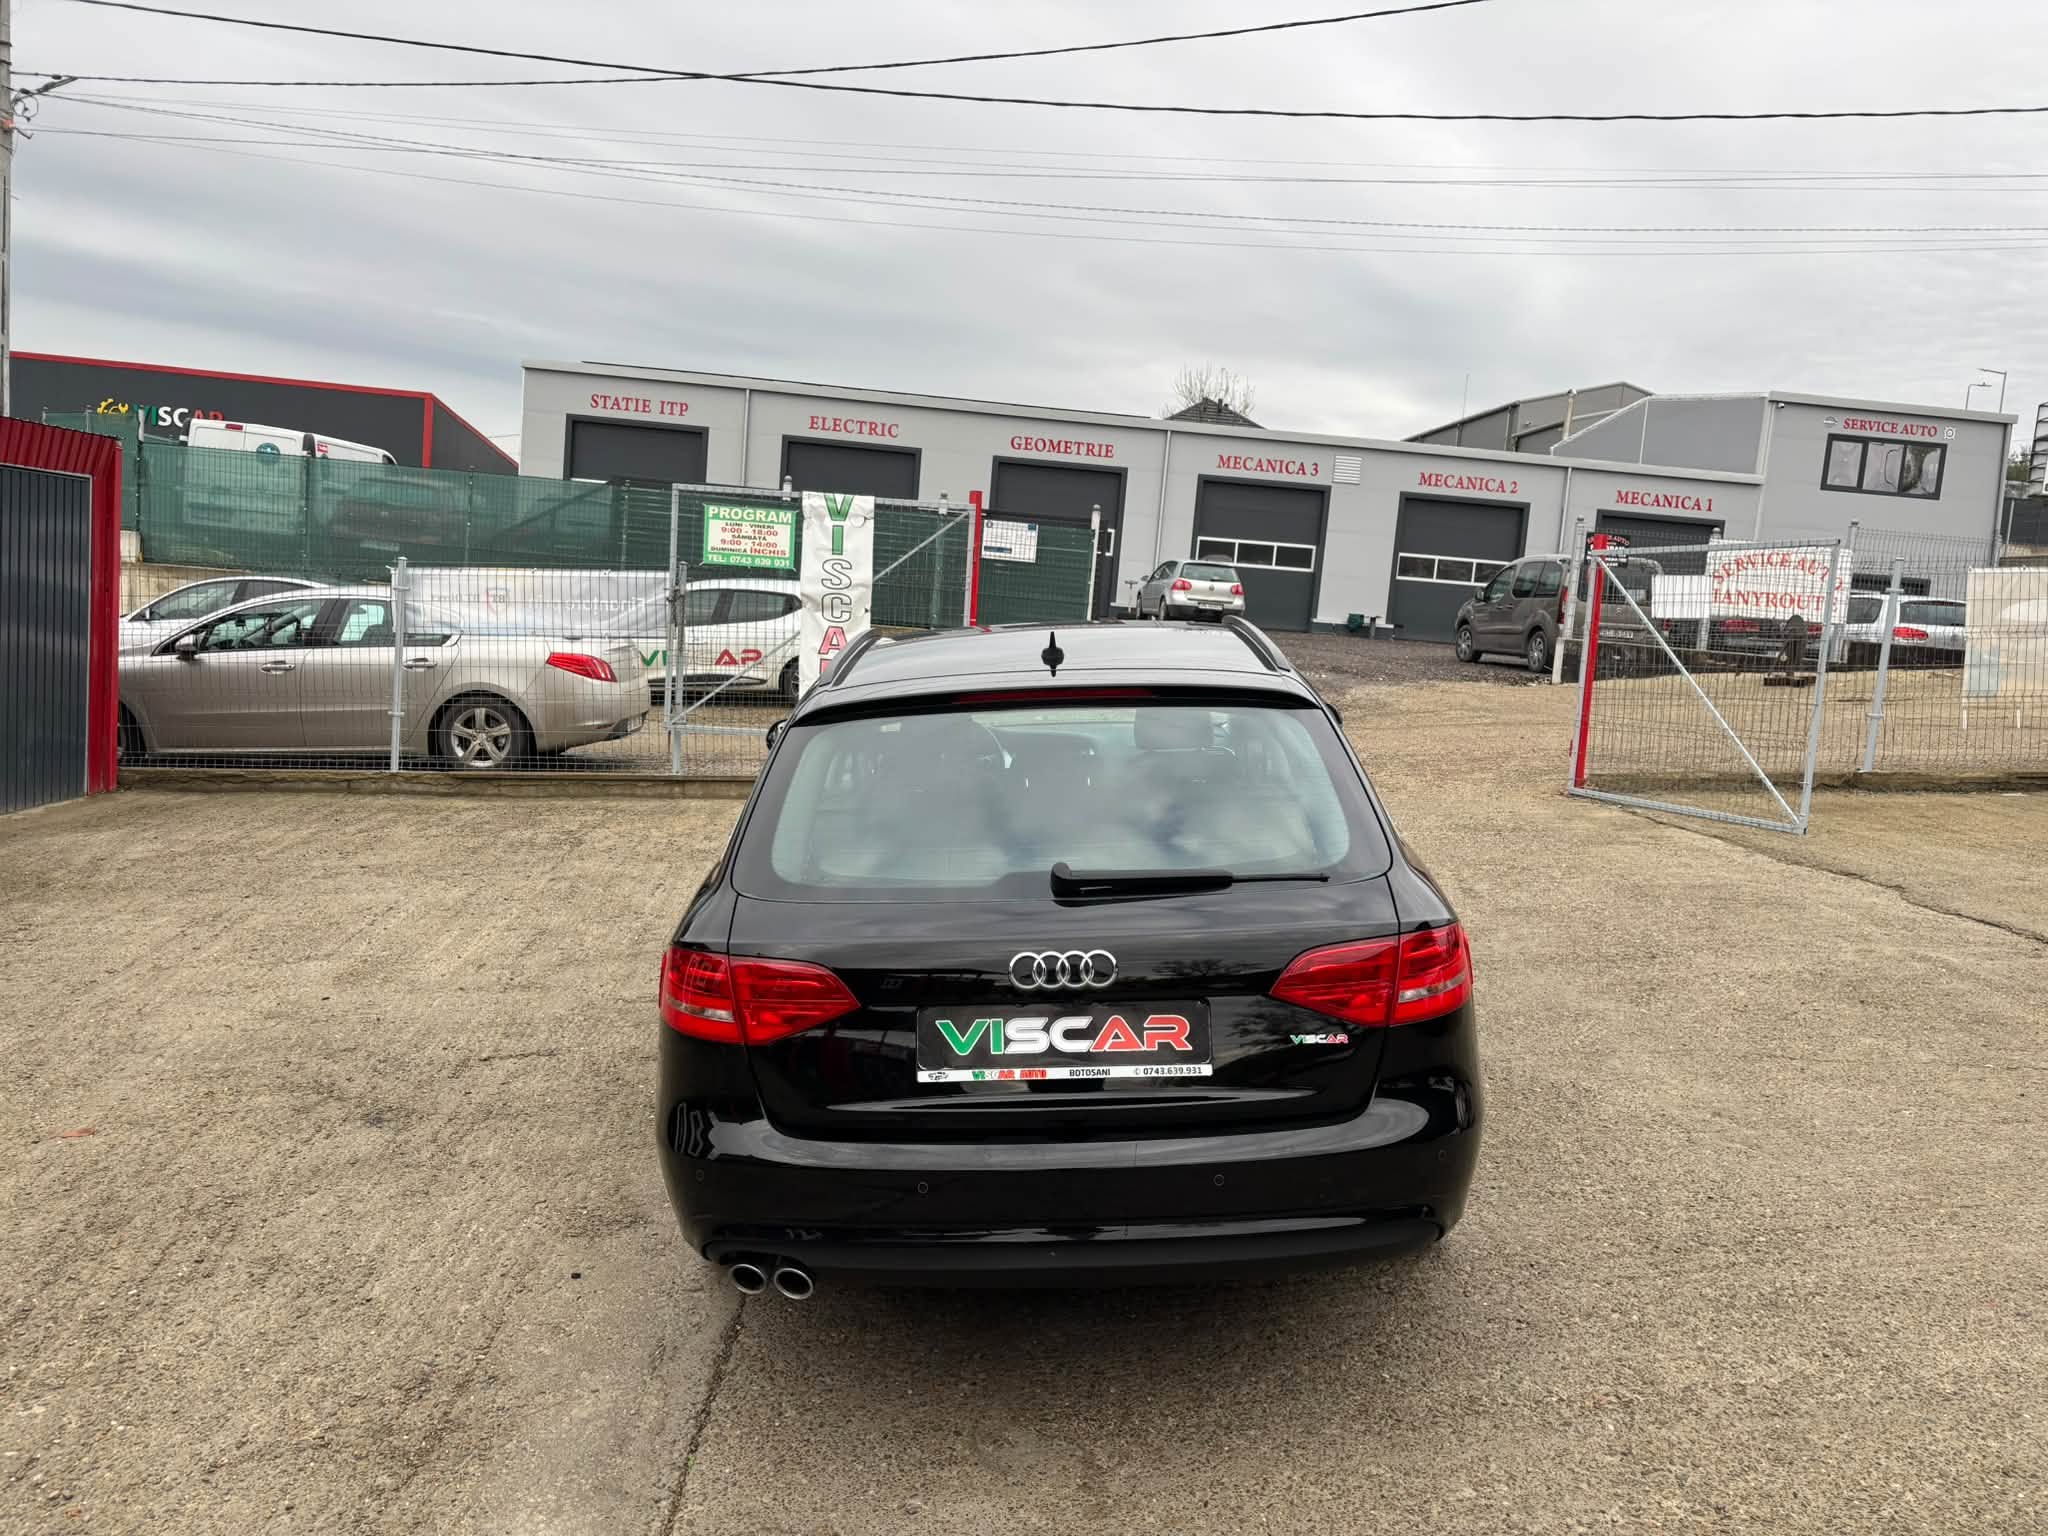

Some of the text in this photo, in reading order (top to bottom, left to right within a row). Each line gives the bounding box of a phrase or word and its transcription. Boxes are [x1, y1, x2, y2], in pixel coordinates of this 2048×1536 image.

[590, 394, 689, 417] STATIE ITP
[809, 415, 899, 438] ELECTRIC
[1843, 417, 1938, 438] SERVICE AUTO
[1010, 435, 1115, 459] GEOMETRIE
[1216, 454, 1320, 477] MECANICA 3
[1418, 471, 1519, 494] MECANICA 2
[1616, 490, 1714, 512] MECANICA 1
[708, 506, 792, 523] PROGRAM
[1712, 551, 1792, 585] SERVICE
[817, 494, 853, 674] VISCA
[935, 1014, 1193, 1055] VISCAR
[1289, 1033, 1349, 1045] VISCAR
[1069, 1068, 1111, 1077] BOTOSANI
[1143, 1066, 1203, 1076] 0743.639.931
